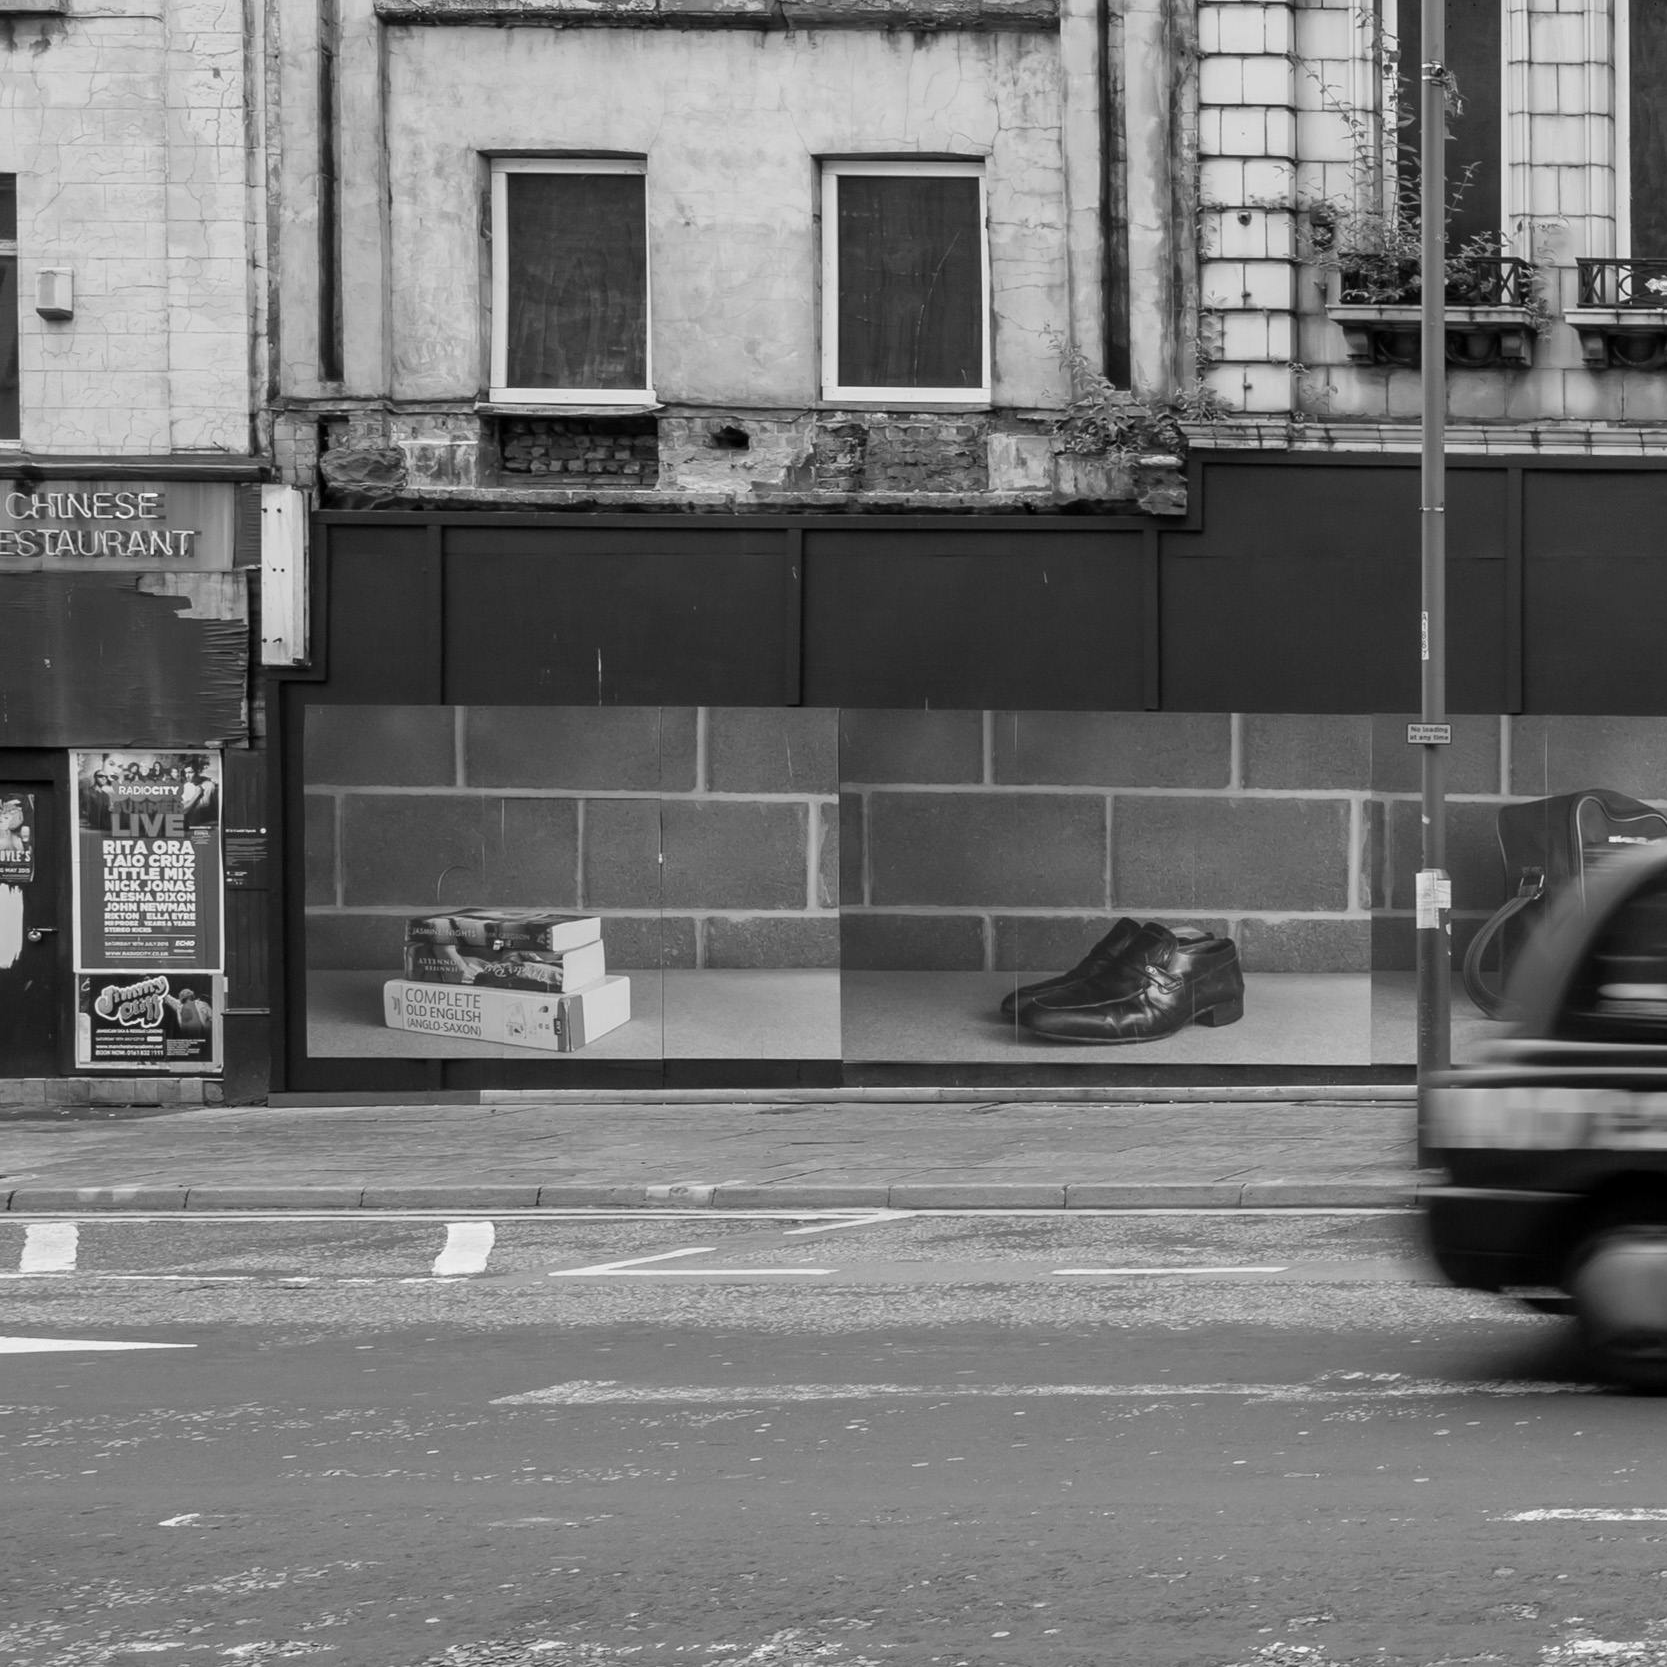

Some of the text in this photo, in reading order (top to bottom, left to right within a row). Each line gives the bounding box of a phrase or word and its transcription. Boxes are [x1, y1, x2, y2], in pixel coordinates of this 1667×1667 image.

[5, 492, 166, 520] CHINESE
[1422, 726, 1449, 734] loading
[118, 785, 180, 796] RADIOCITY
[111, 813, 185, 838] LIVE
[102, 840, 195, 855] RITA ORA
[103, 855, 196, 867] TAIO CRUZ
[103, 867, 195, 880] LITTLE MIX
[104, 880, 196, 891] NICK JONAS
[103, 892, 196, 902] ALESHA DIXON
[104, 903, 196, 912] JOHN NEWMAN
[104, 912, 196, 920] RIXTON ELLA EYRE
[96, 976, 168, 1016] Jimmy
[405, 988, 481, 1010] COMPLETE
[406, 1004, 481, 1023] OLD ENGLISH
[407, 1018, 482, 1037] (ANGLO-SAXON)
